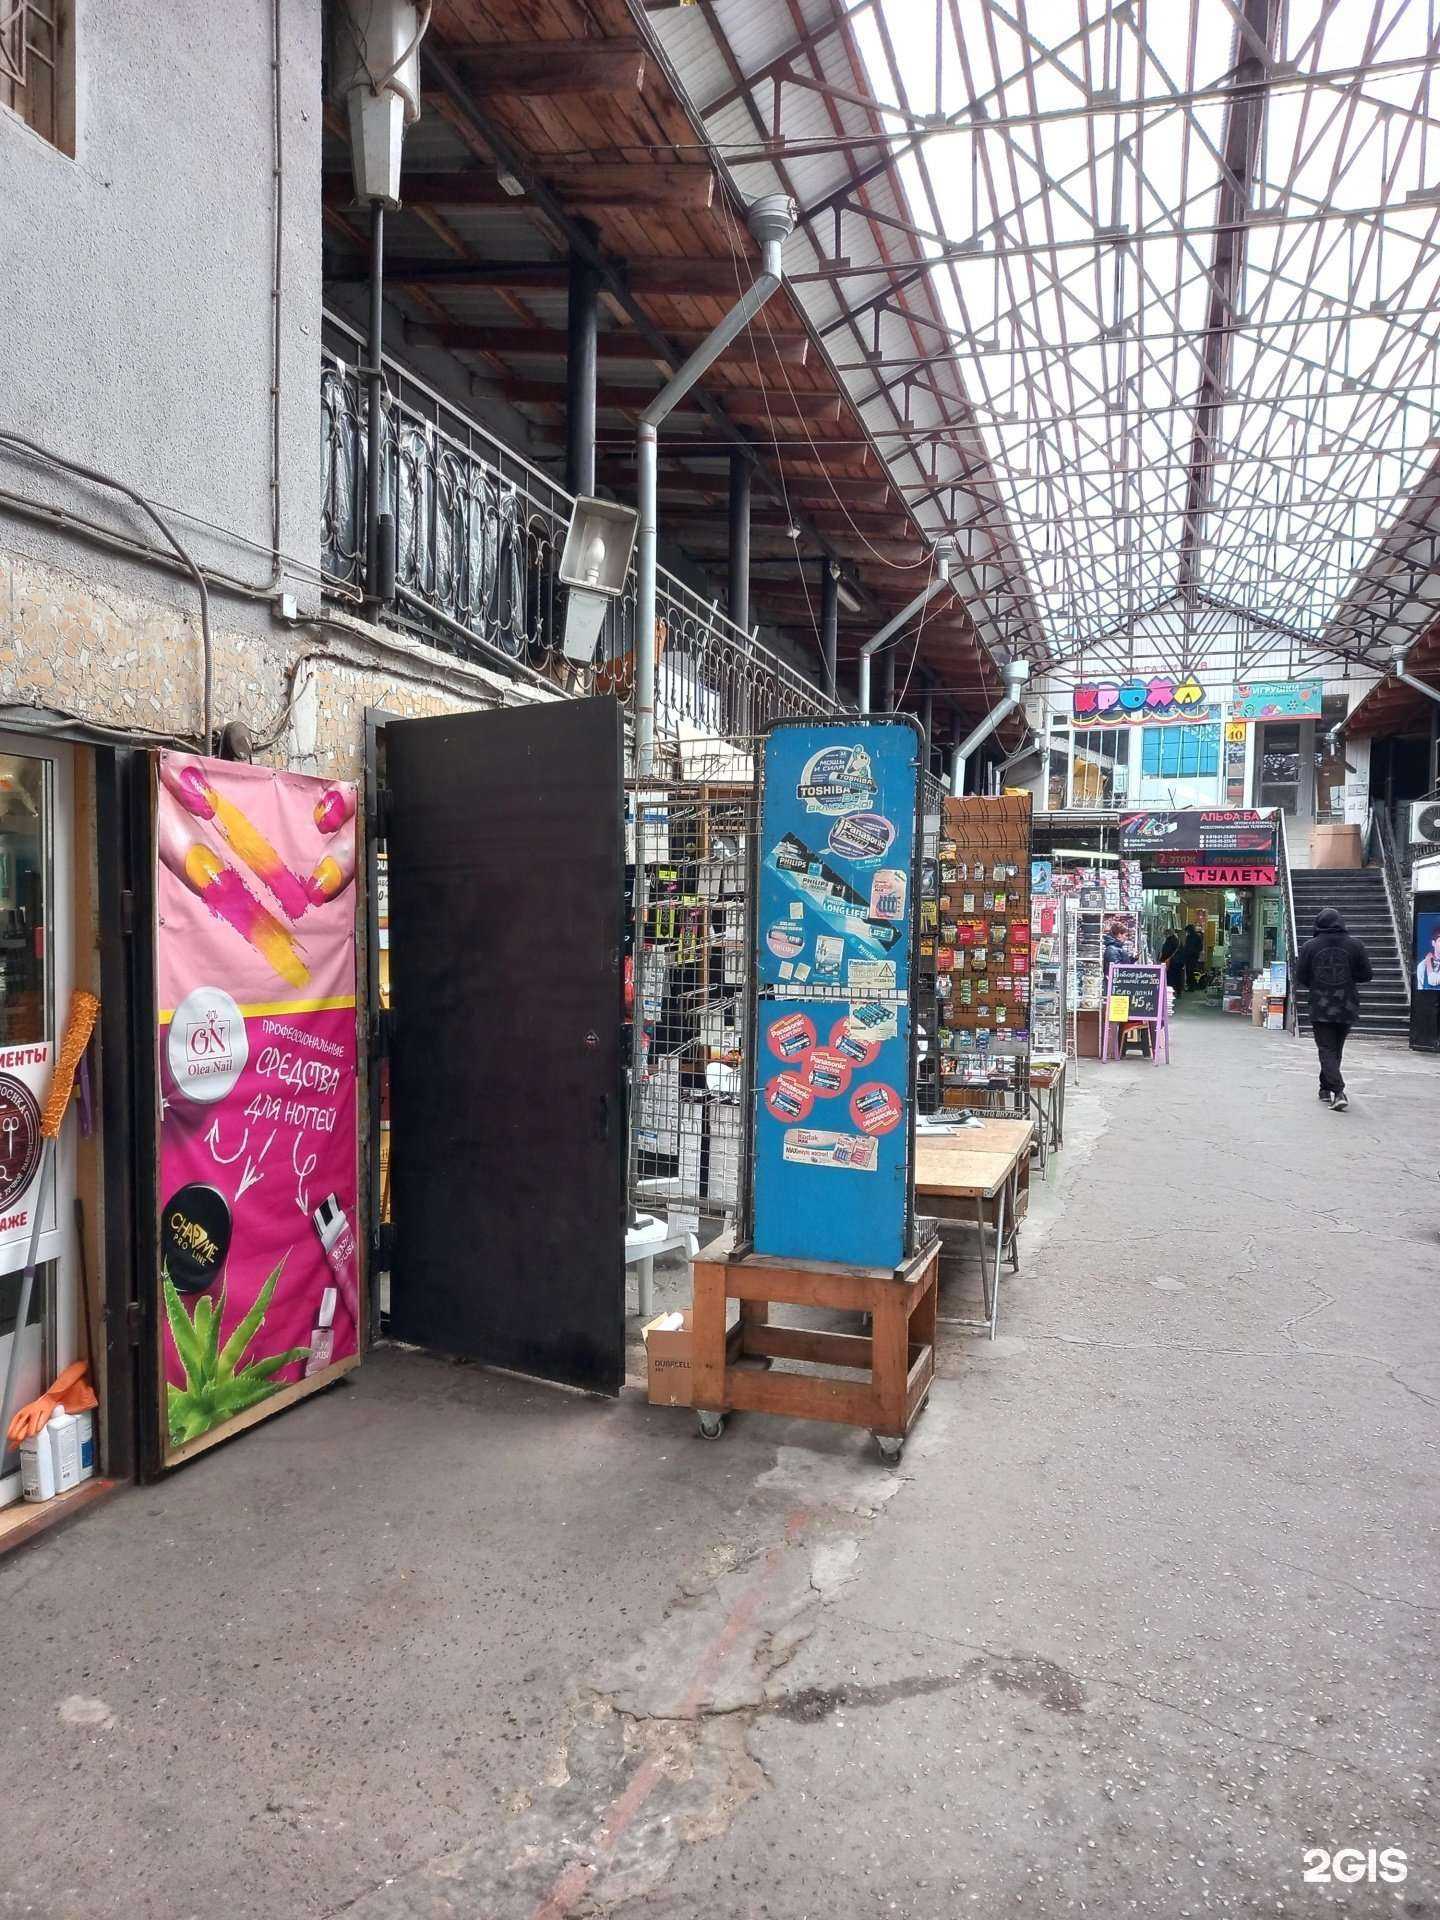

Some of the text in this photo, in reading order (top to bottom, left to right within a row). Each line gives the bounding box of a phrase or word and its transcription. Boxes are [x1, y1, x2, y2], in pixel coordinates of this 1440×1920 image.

[1074, 675, 1206, 712] КРОХА
[1252, 684, 1300, 695] ИГРУШКИ
[1229, 730, 1243, 740] 40
[840, 774, 873, 785] TOSHIBA
[800, 786, 851, 796] TOSHIBA
[844, 821, 886, 849] Panasonic
[779, 858, 807, 868] PHILIPS
[1160, 854, 1196, 864] 2 этаж
[802, 877, 829, 887] PHILIPS
[1196, 869, 1263, 882] ТУАЛЕТ
[1131, 995, 1145, 1007] 45
[771, 1018, 805, 1038] Panasonic
[262, 1019, 344, 1058] ПРОФЕССИОНАЛЬНЫЕ
[187, 1059, 233, 1076] Olea Nail
[256, 1047, 341, 1095] СРЕДСТВА
[810, 1055, 847, 1070] Panasonic
[776, 1077, 810, 1099] Panasonic
[244, 1093, 337, 1133] ДЛЯ НОГТЕЙ
[862, 1108, 898, 1127] Panasonic
[170, 1212, 219, 1264] CHARME
[173, 1234, 206, 1267] PRO LINE
